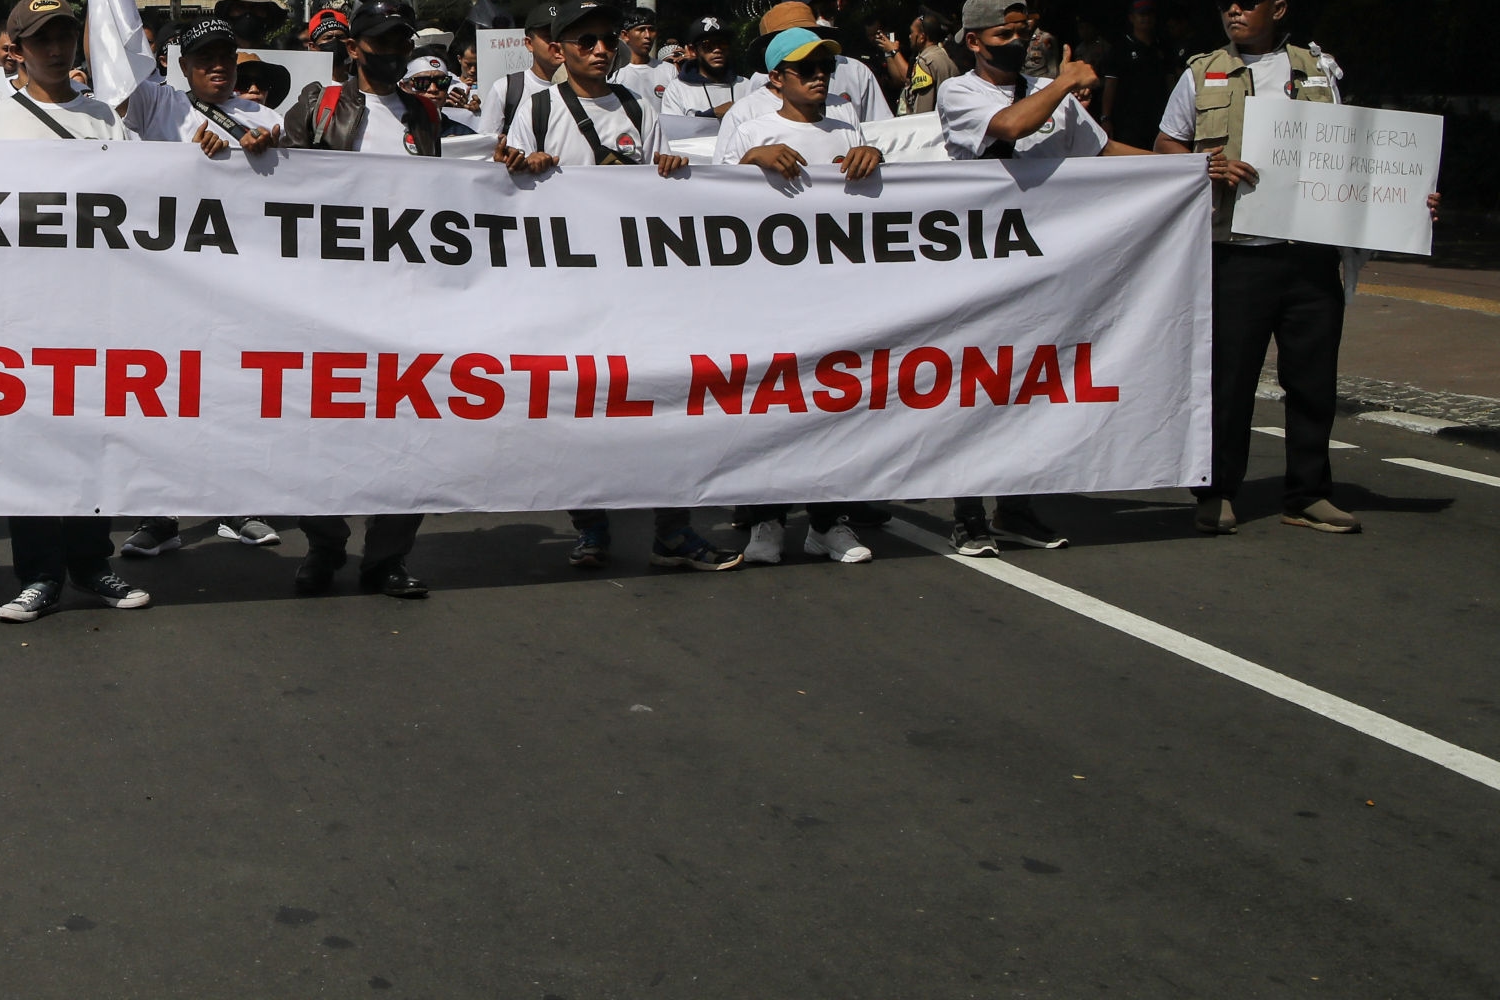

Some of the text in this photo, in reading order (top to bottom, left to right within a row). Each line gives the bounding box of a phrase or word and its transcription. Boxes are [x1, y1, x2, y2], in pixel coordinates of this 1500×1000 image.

[1274, 120, 1418, 149] KAMI BUTUH KERJA
[1272, 149, 1423, 177] KAMI PERLU PENGHASILAN
[1297, 180, 1407, 204] TOLONG KAMI
[264, 201, 598, 268] TEKSTIL
[619, 207, 1045, 268] INDONESIA
[240, 351, 655, 421] TEKSTIL
[685, 342, 1120, 416] NASIONAL
